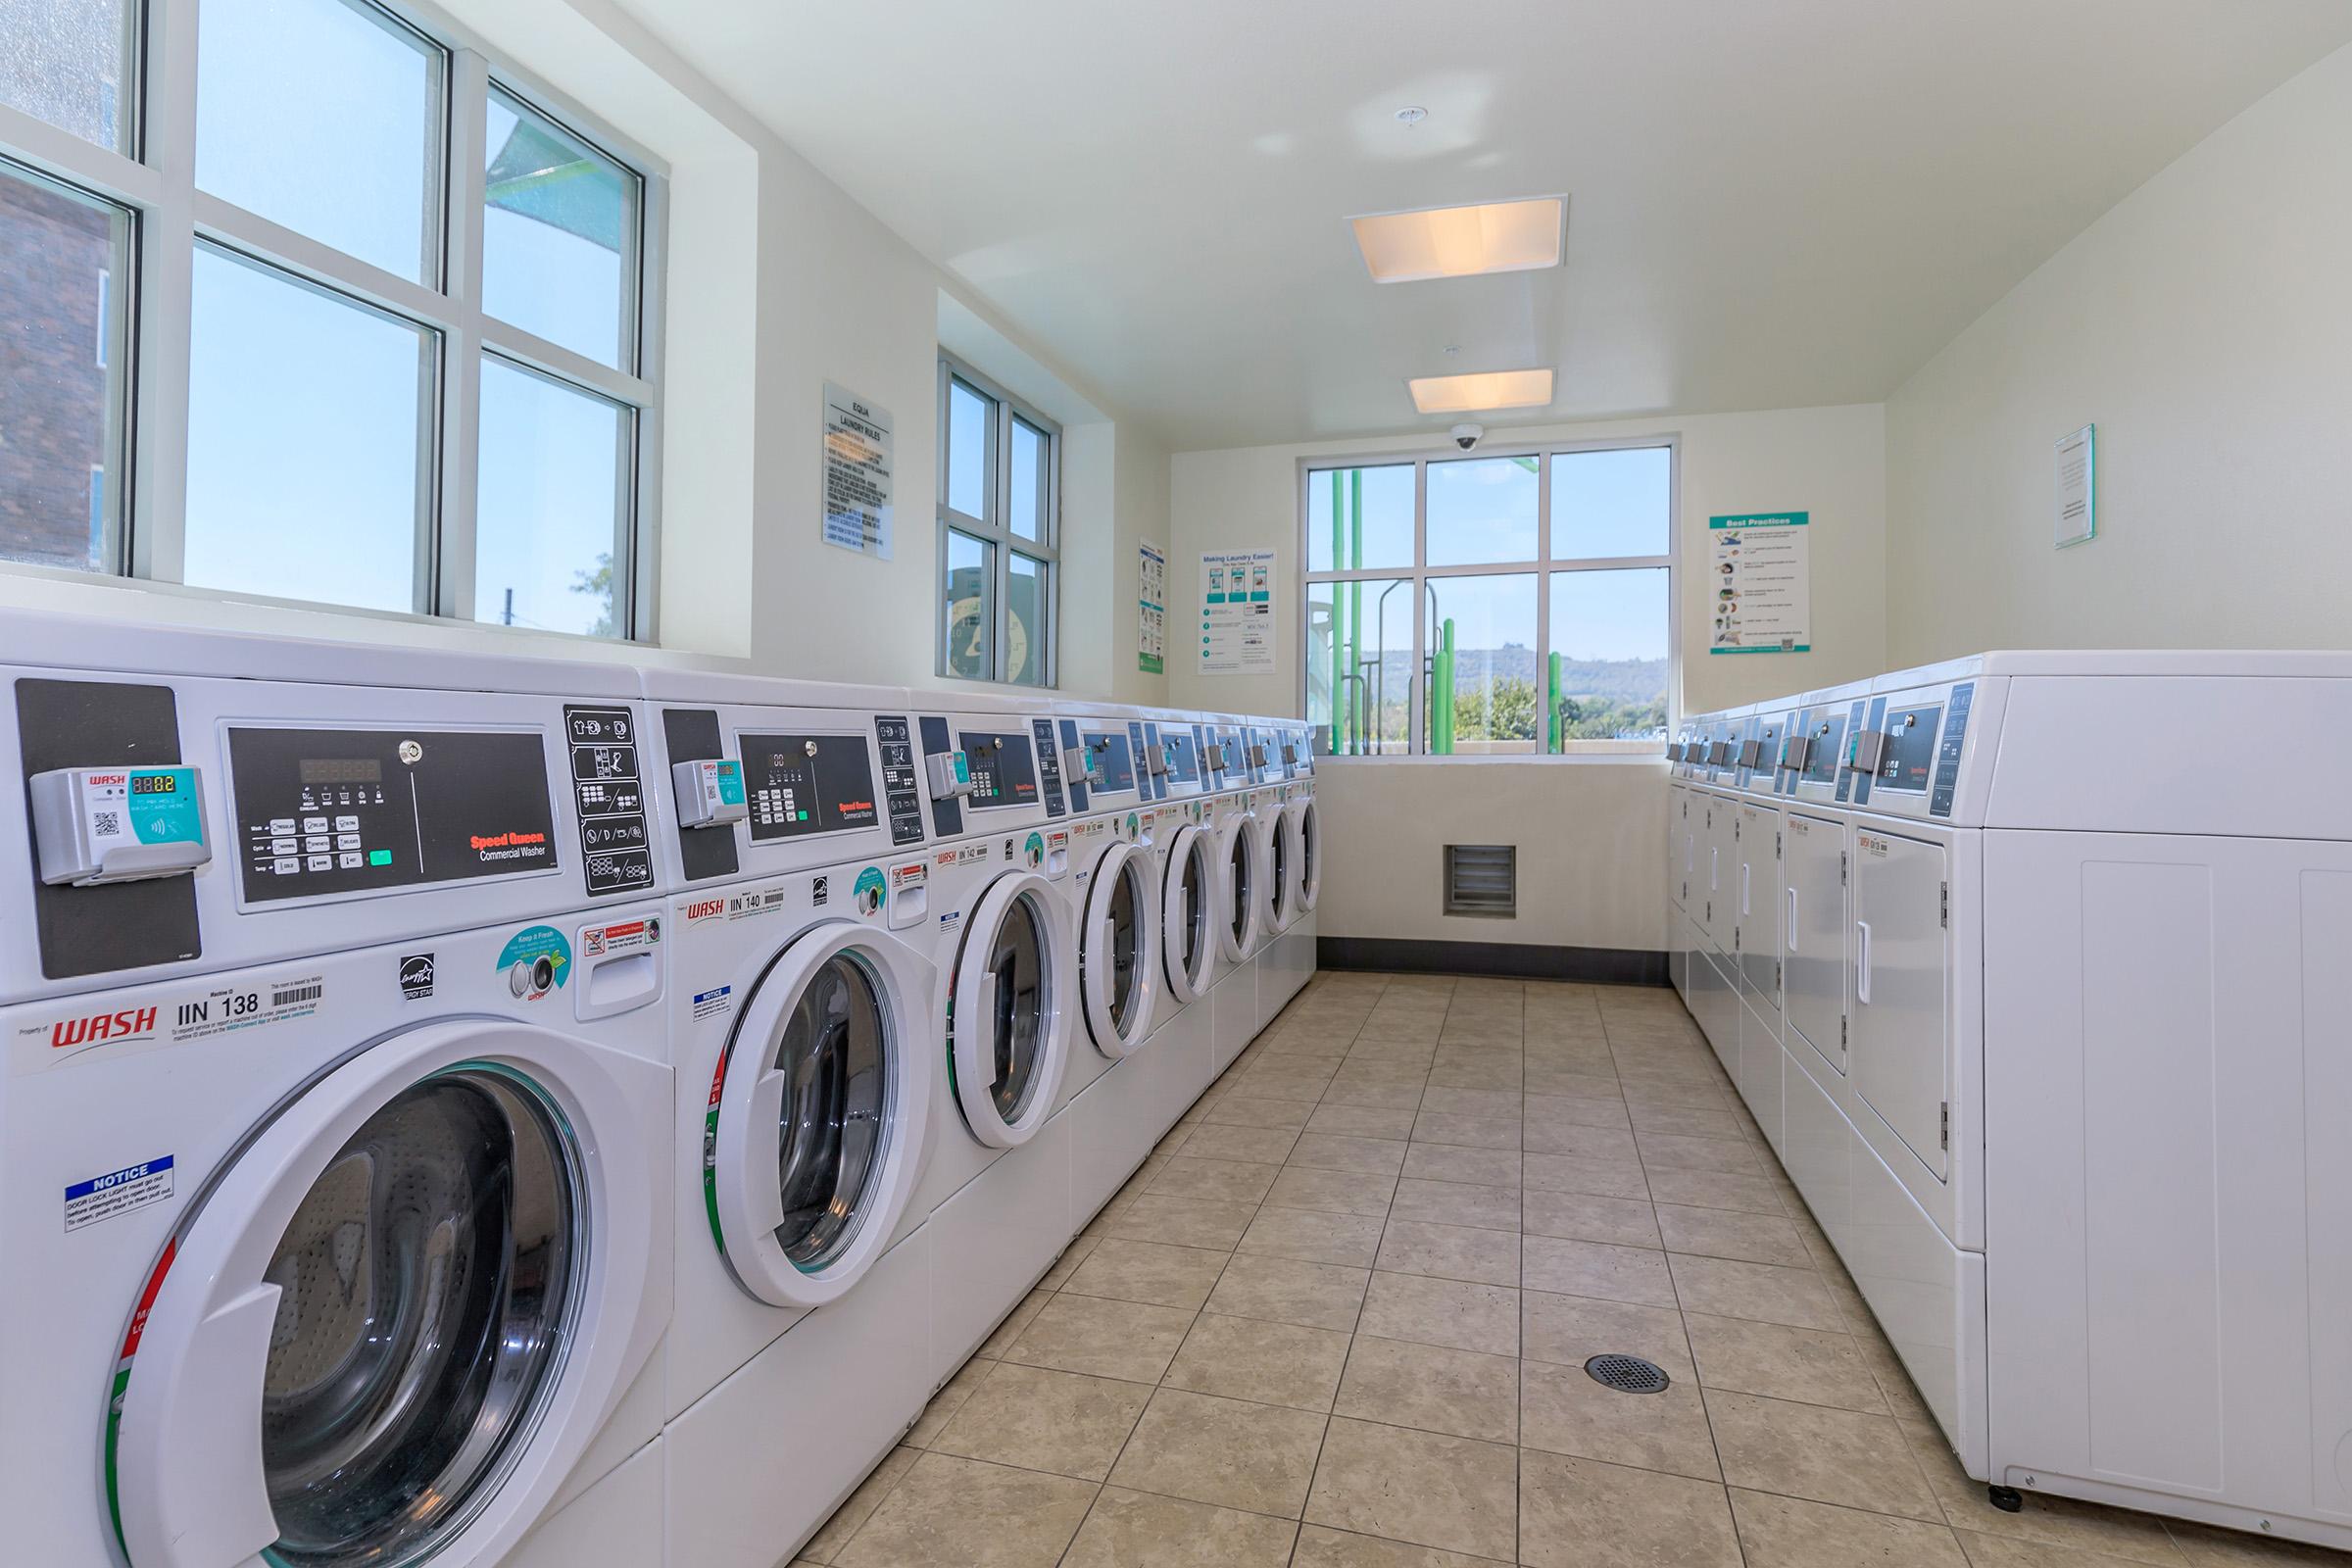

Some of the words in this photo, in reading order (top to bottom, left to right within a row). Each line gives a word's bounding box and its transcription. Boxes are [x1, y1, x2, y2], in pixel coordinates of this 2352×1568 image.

[853, 402, 869, 417] EQUA
[840, 415, 864, 434] LAUNDRY
[864, 426, 881, 442] RULES
[1747, 517, 1790, 526] Practices
[89, 775, 126, 785] WASH
[838, 802, 857, 812] Speed
[470, 833, 509, 851] Speed
[509, 832, 545, 845] Queen
[479, 848, 520, 861] Commercial
[520, 847, 546, 858] Washer
[938, 851, 956, 863] WASH
[688, 899, 724, 919] WASH
[730, 898, 742, 911] IIN
[746, 895, 760, 908] 140
[419, 988, 432, 997] STAR
[703, 989, 722, 1001] NOTICE
[178, 1001, 208, 1026] IIN
[221, 993, 259, 1017] 138
[51, 1006, 158, 1048] WASH
[93, 1164, 149, 1191] NOTICE
[67, 1199, 88, 1210] DOOR
[88, 1193, 108, 1203] LOCK
[108, 1186, 128, 1198] LIGHT
[67, 1207, 88, 1218] before
[89, 1197, 122, 1213] attempting
[129, 1188, 146, 1199] open
[94, 1207, 111, 1218] push
[112, 1202, 126, 1211] door
[134, 1195, 148, 1203] then
[148, 1190, 161, 1200] pull
